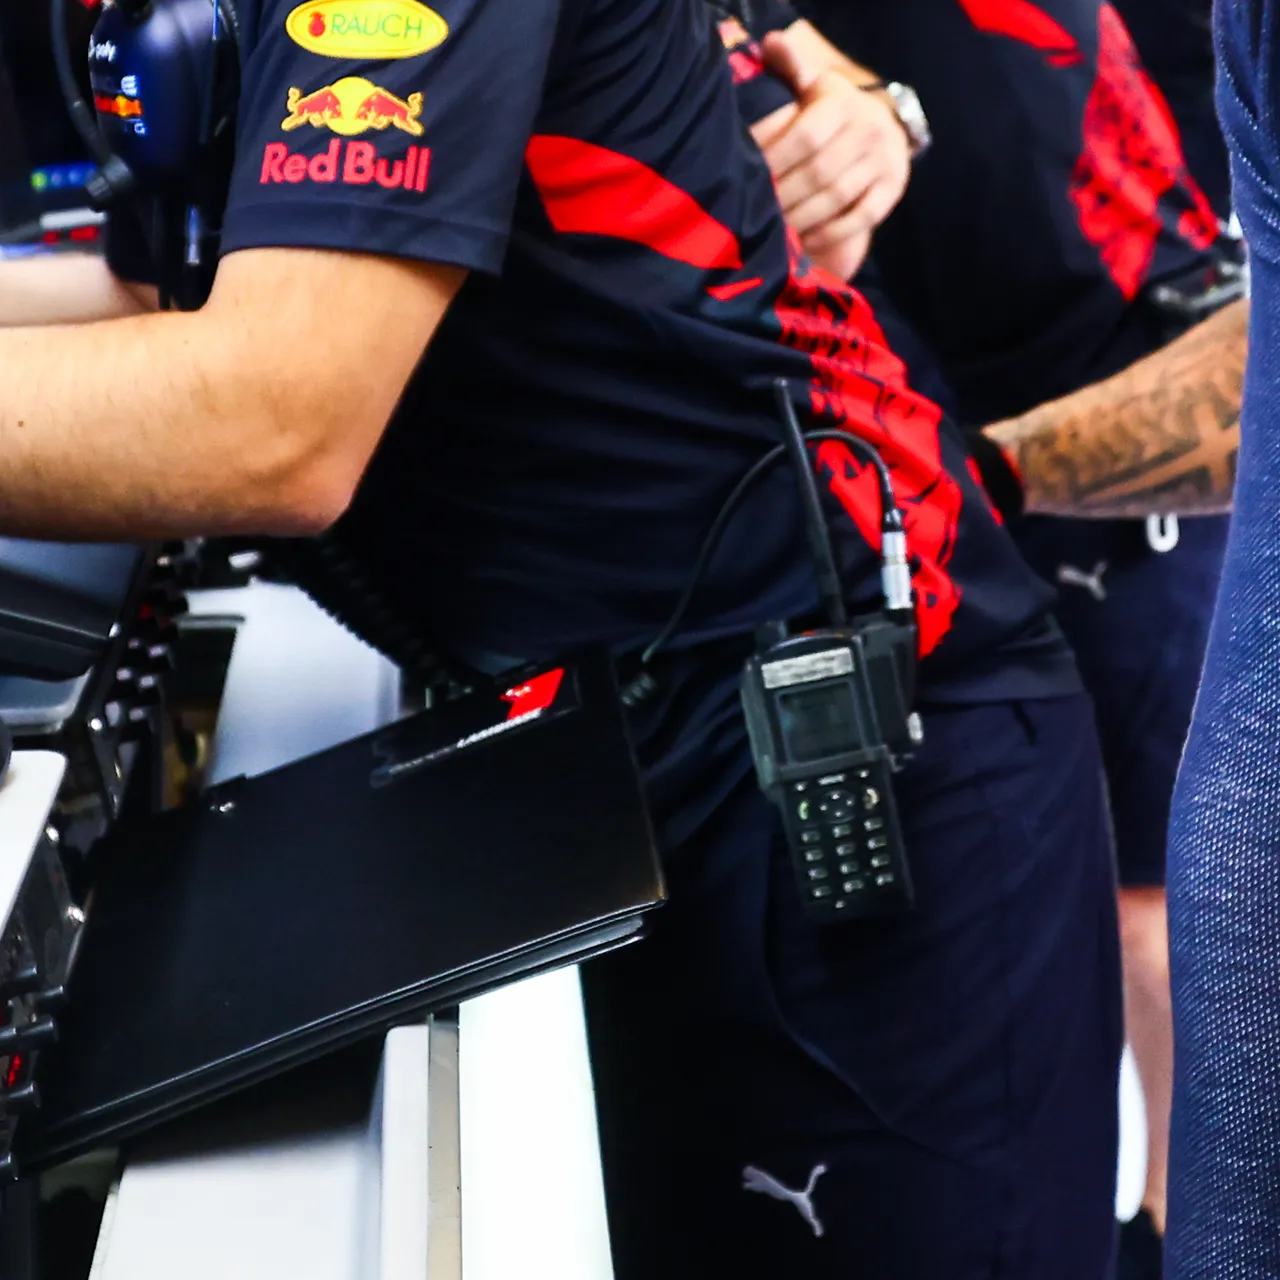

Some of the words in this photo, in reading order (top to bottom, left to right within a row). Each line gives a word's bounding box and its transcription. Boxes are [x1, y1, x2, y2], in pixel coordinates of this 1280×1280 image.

[330, 12, 423, 40] RAUCH
[260, 137, 341, 186] Red
[343, 140, 432, 193] Bull
